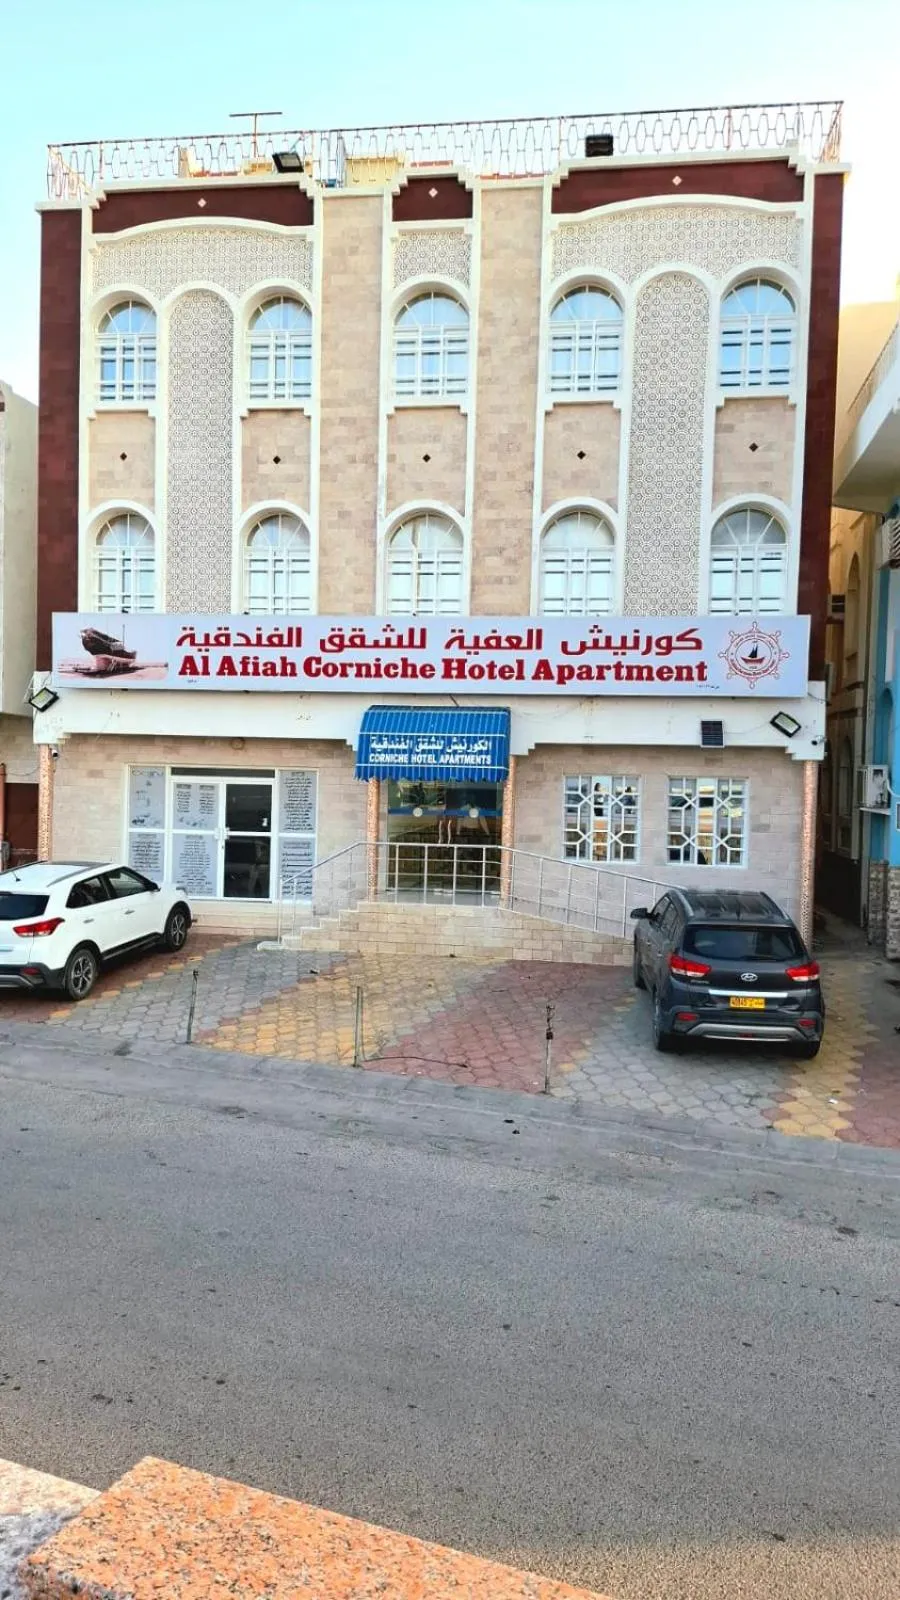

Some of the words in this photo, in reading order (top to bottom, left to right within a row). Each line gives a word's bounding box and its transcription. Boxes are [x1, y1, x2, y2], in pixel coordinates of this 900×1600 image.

[177, 627, 303, 654] الفندقية
[319, 625, 427, 654] للشقق
[445, 627, 543, 656] العفية
[560, 625, 704, 656] كورنيش
[179, 655, 211, 677] Al
[217, 655, 297, 678] Afiah
[302, 656, 435, 679] Corniche
[442, 657, 525, 681] Hotel
[532, 659, 706, 685] Apartment
[369, 754, 409, 763] CORNICHE
[411, 754, 436, 764] HOTEL
[438, 755, 492, 765] APARTMENTS
